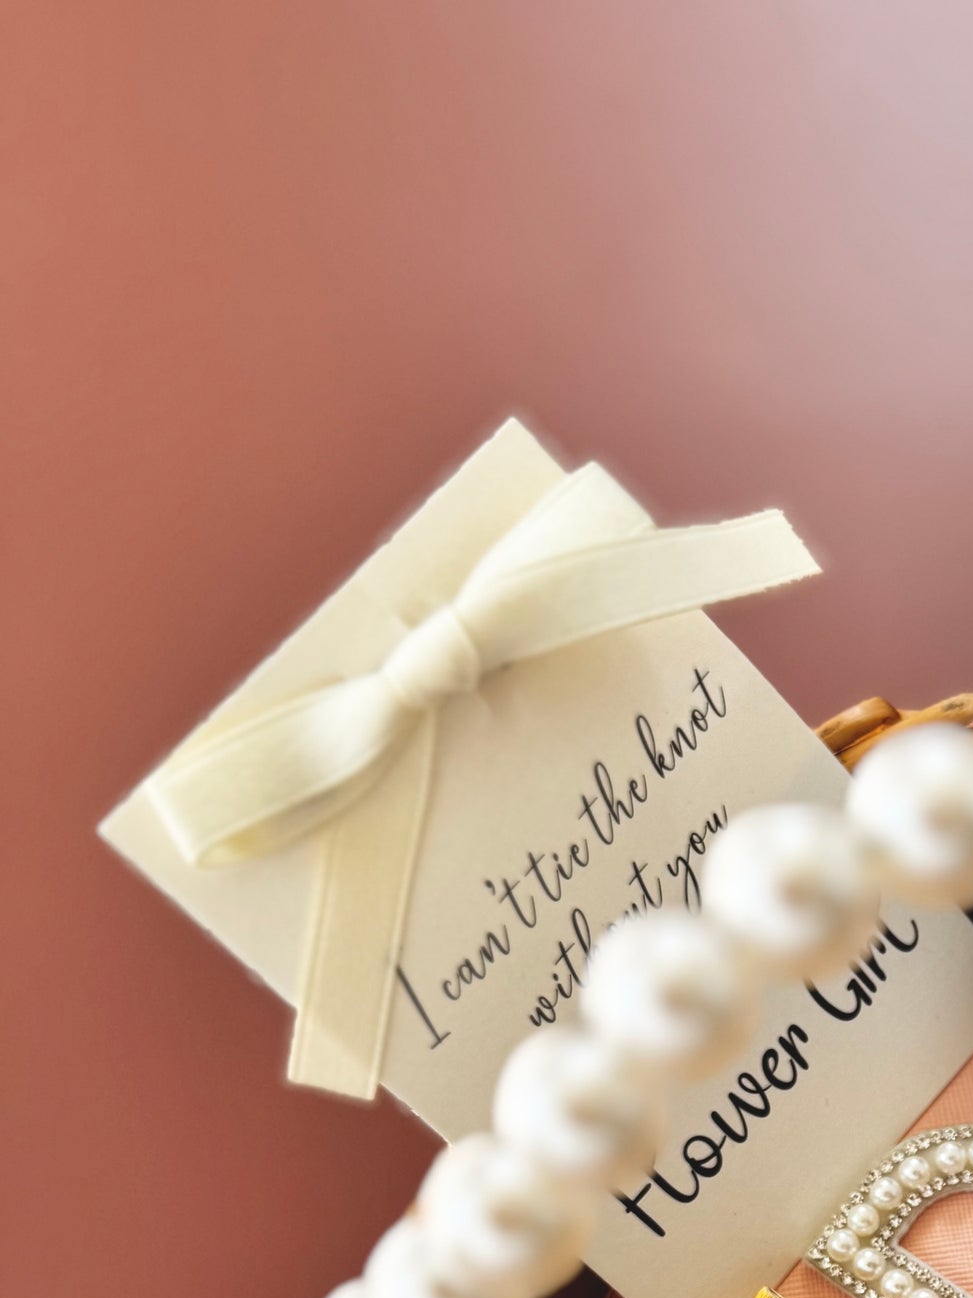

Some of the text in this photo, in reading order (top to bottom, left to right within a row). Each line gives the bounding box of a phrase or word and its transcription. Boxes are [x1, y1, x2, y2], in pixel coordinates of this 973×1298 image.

[396, 667, 728, 1050] I can't tie the knot
[666, 804, 729, 914] you
